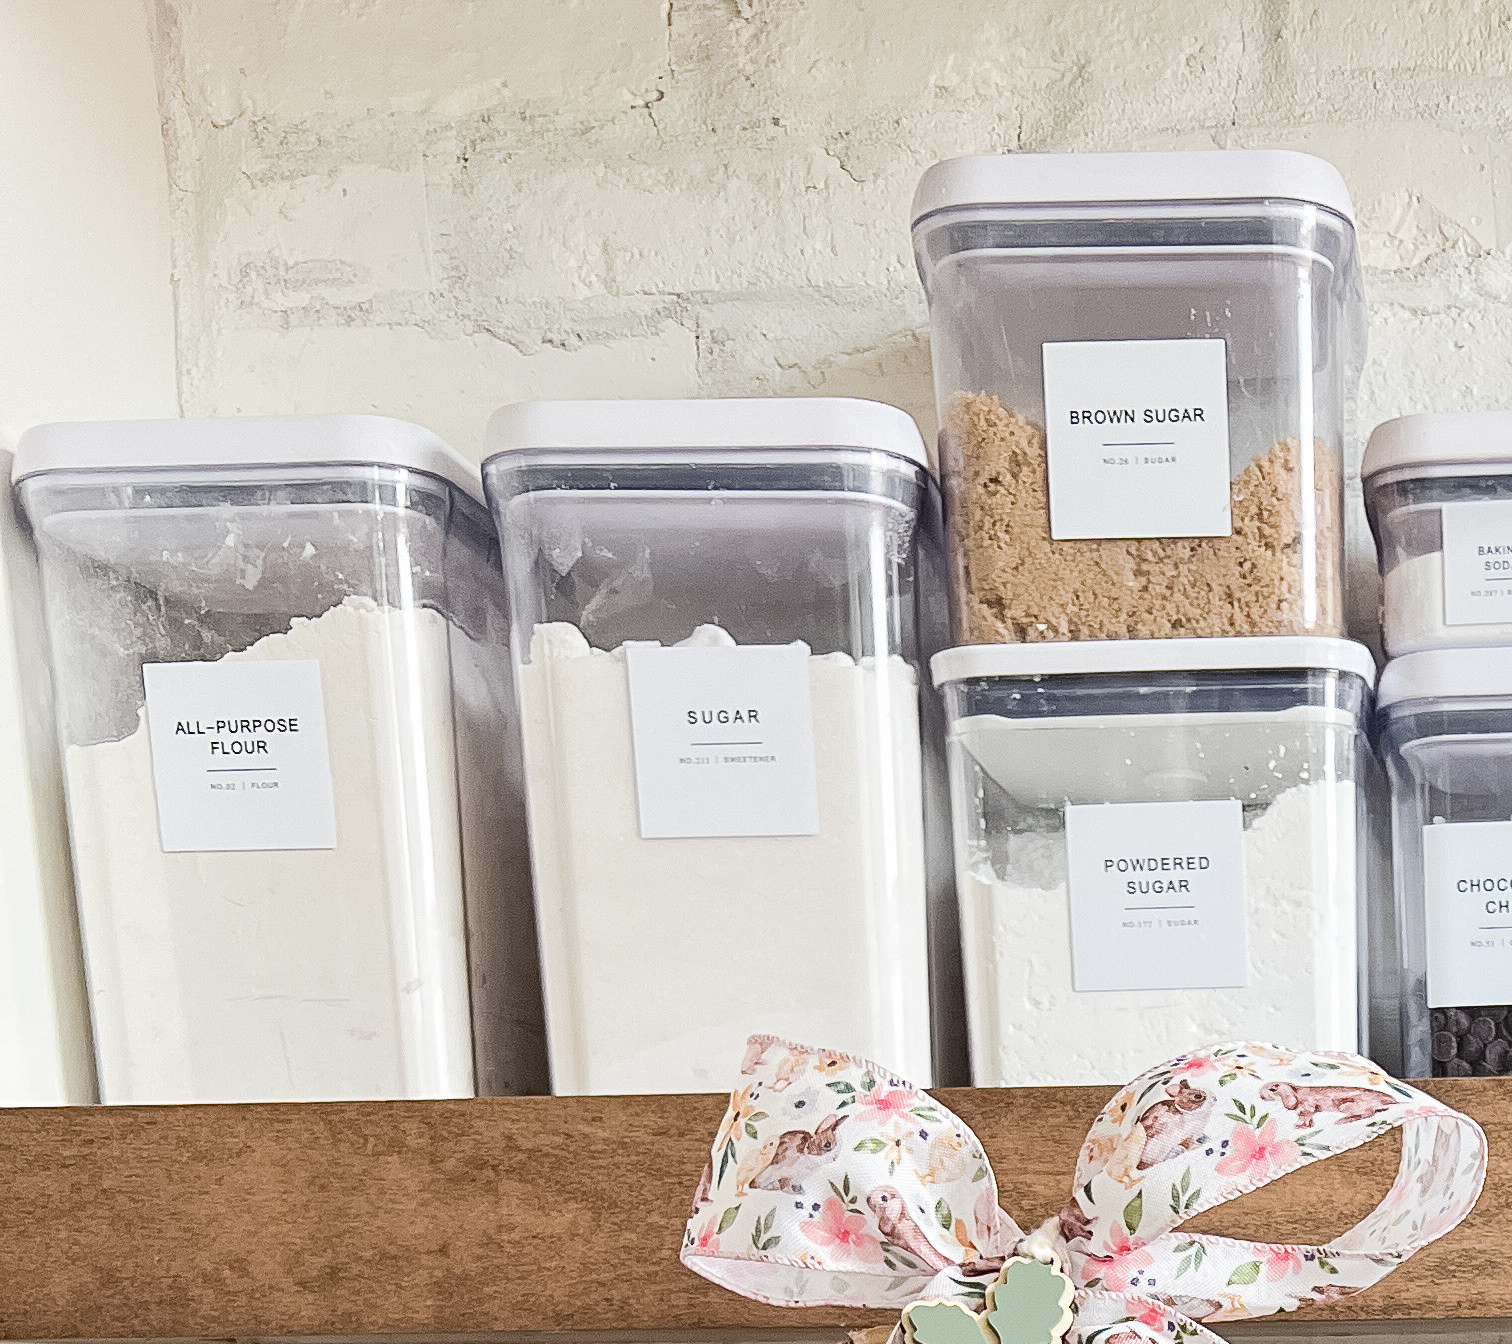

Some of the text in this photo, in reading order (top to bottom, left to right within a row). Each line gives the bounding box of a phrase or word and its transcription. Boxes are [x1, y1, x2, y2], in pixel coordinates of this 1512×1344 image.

[1069, 407, 1206, 425] BROWN SUGAR
[1143, 456, 1177, 465] SUGAR
[687, 709, 761, 725] SUGAR
[174, 717, 300, 735] ALL-PURPOSE
[210, 740, 269, 755] FLOUR
[250, 781, 280, 790] FLOUR
[1104, 856, 1211, 873] POWDERED
[1126, 879, 1191, 895] SUGAR
[1166, 919, 1200, 928] SUGAR
